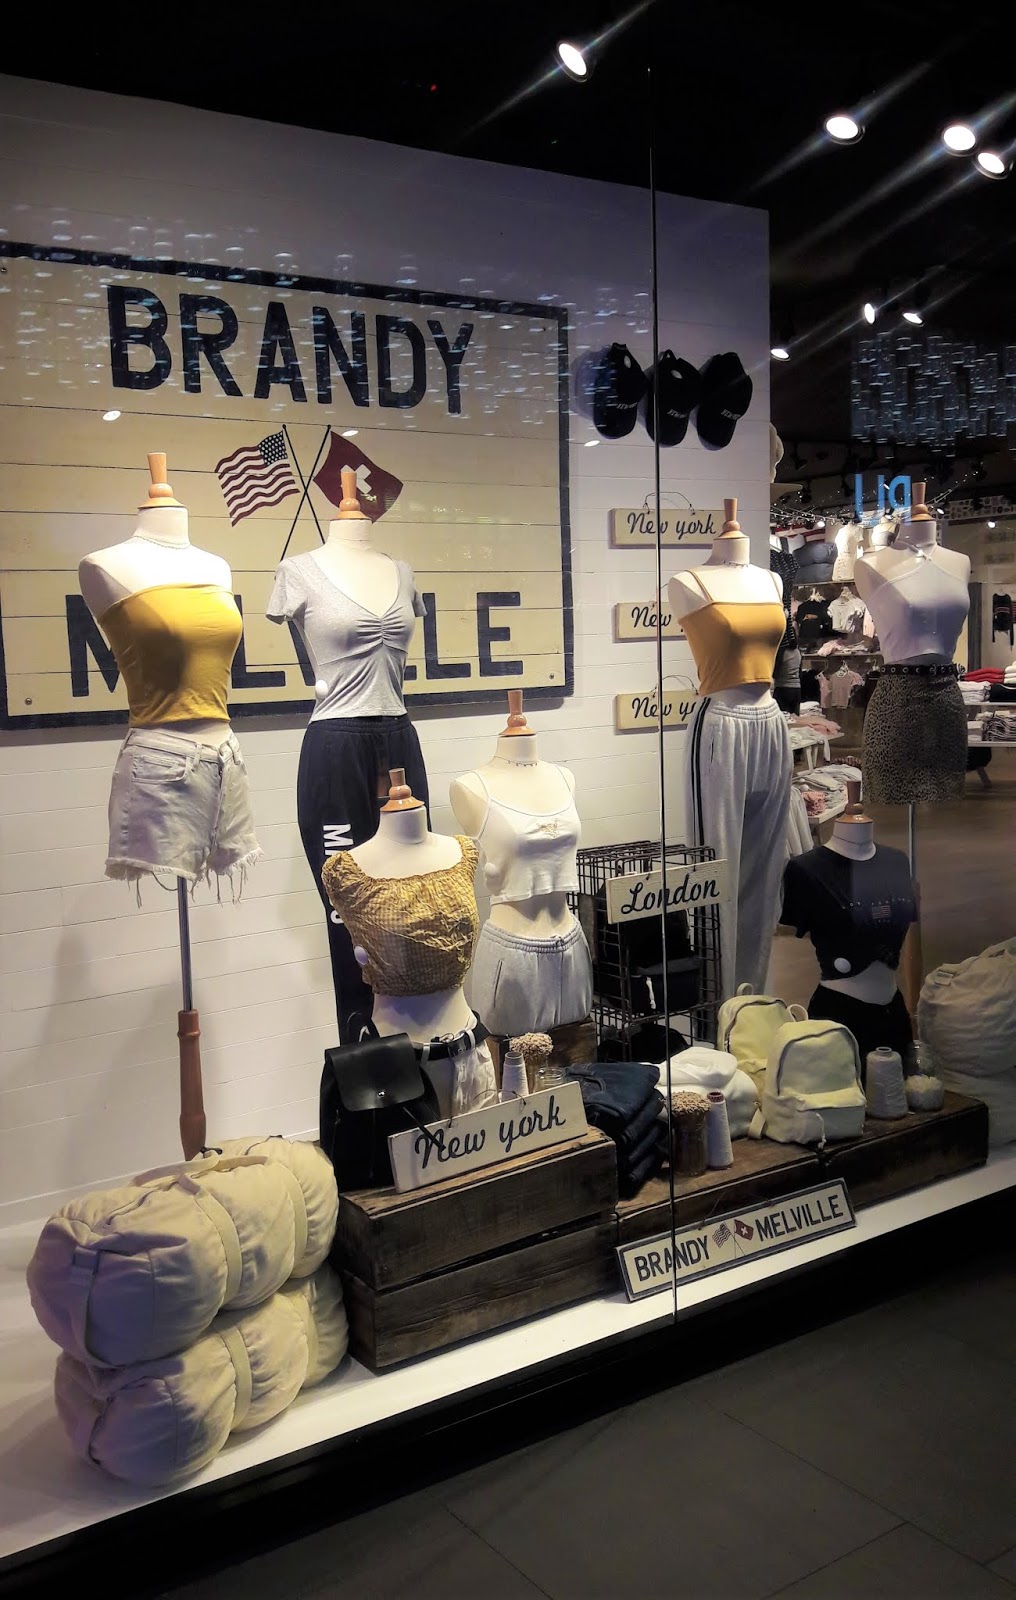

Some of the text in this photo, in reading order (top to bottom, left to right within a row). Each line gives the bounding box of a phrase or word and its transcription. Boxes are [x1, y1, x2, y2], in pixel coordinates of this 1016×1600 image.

[107, 285, 474, 414] BRANDY
[627, 512, 717, 540] New york
[631, 606, 672, 628] New
[631, 697, 672, 719] New
[621, 873, 720, 914] London
[414, 1094, 566, 1169] New york
[634, 1195, 844, 1282] BRANDY MELVILLE
